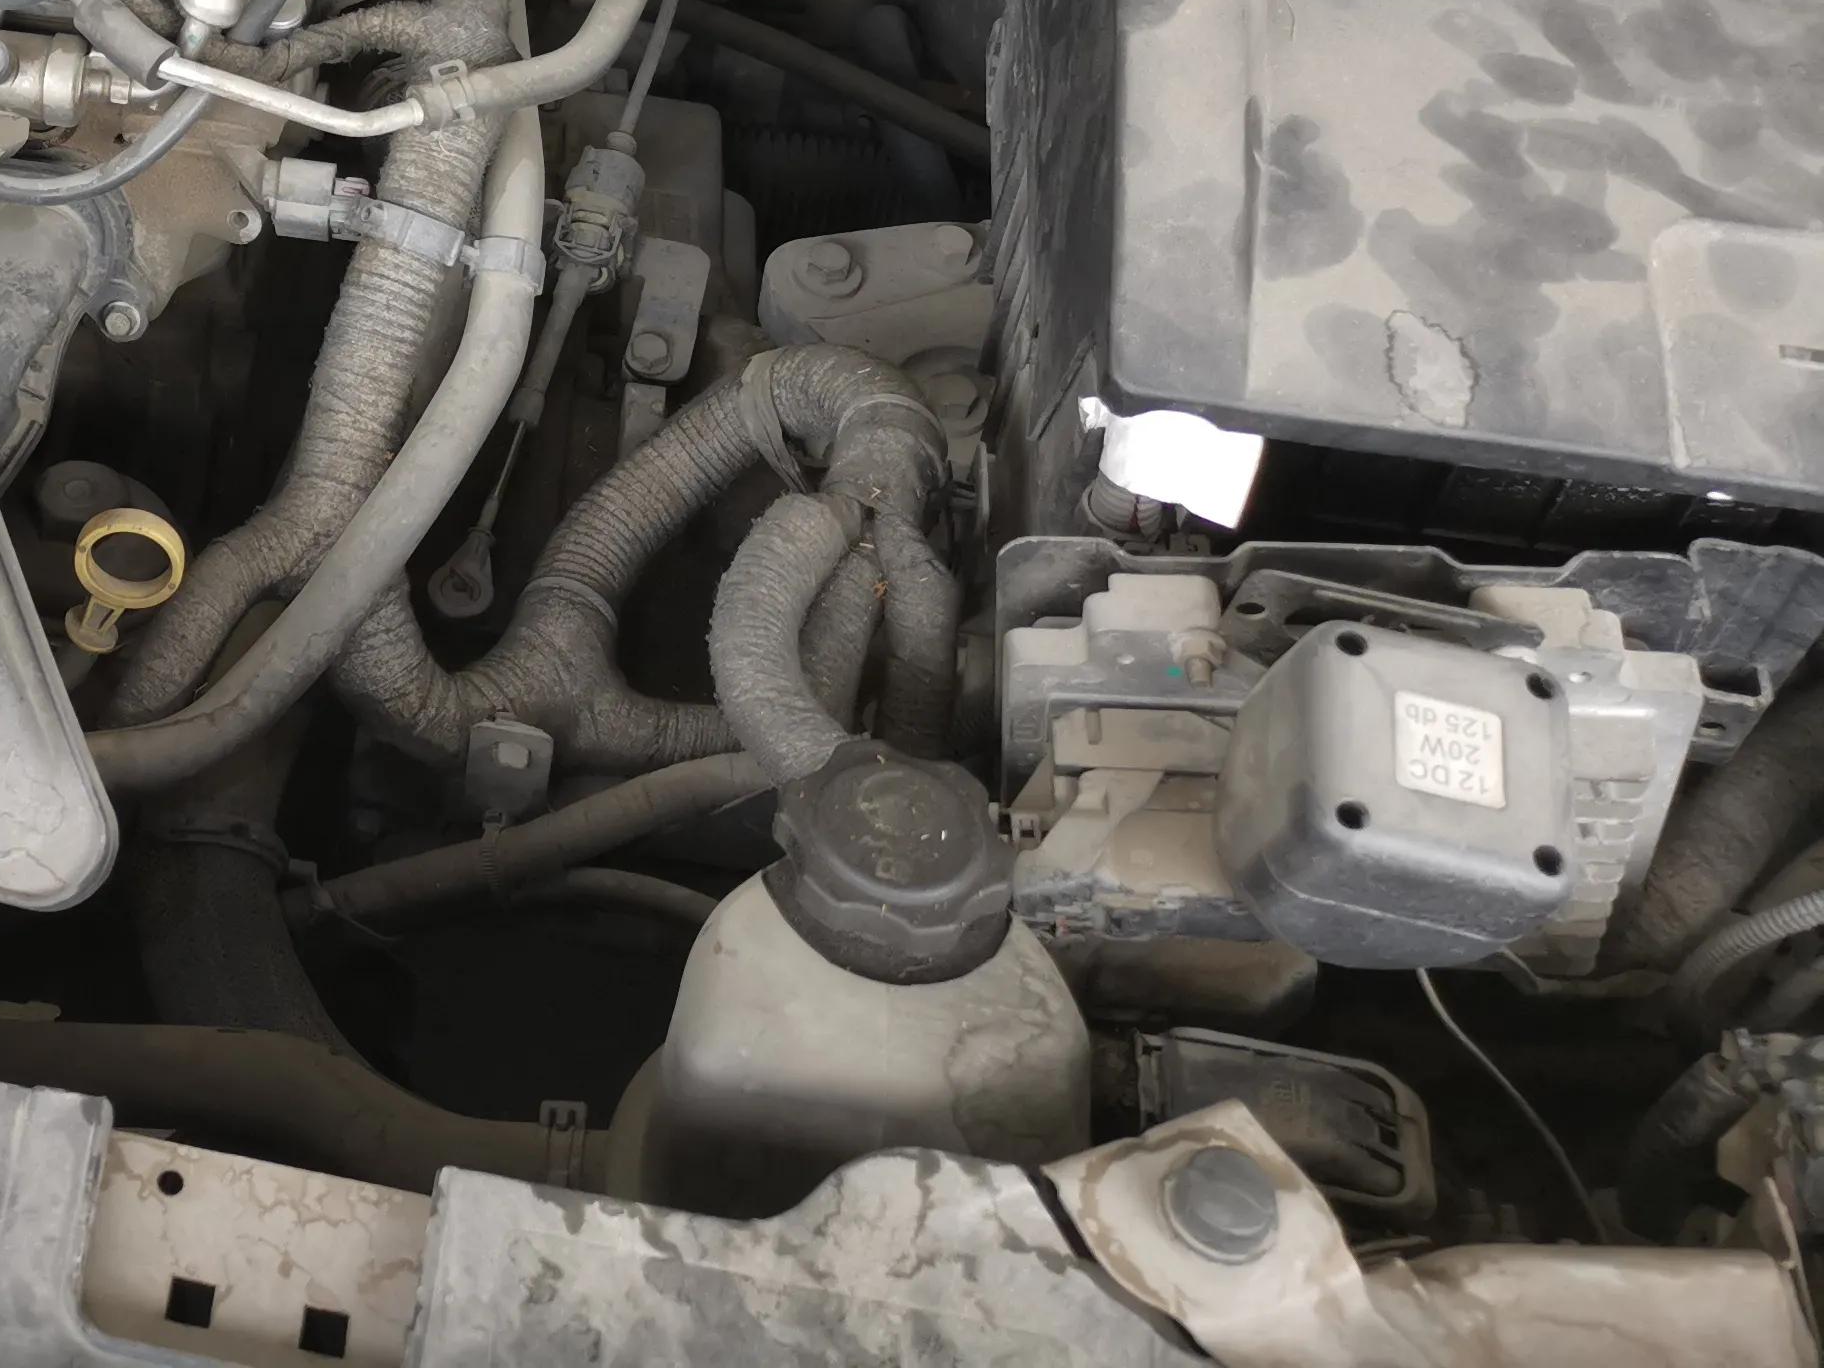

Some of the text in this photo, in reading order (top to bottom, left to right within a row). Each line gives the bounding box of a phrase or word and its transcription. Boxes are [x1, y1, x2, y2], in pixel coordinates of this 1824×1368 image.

[1405, 703, 1493, 742] 125 db
[1420, 734, 1482, 766] 20W
[1408, 758, 1489, 796] 12 DC
